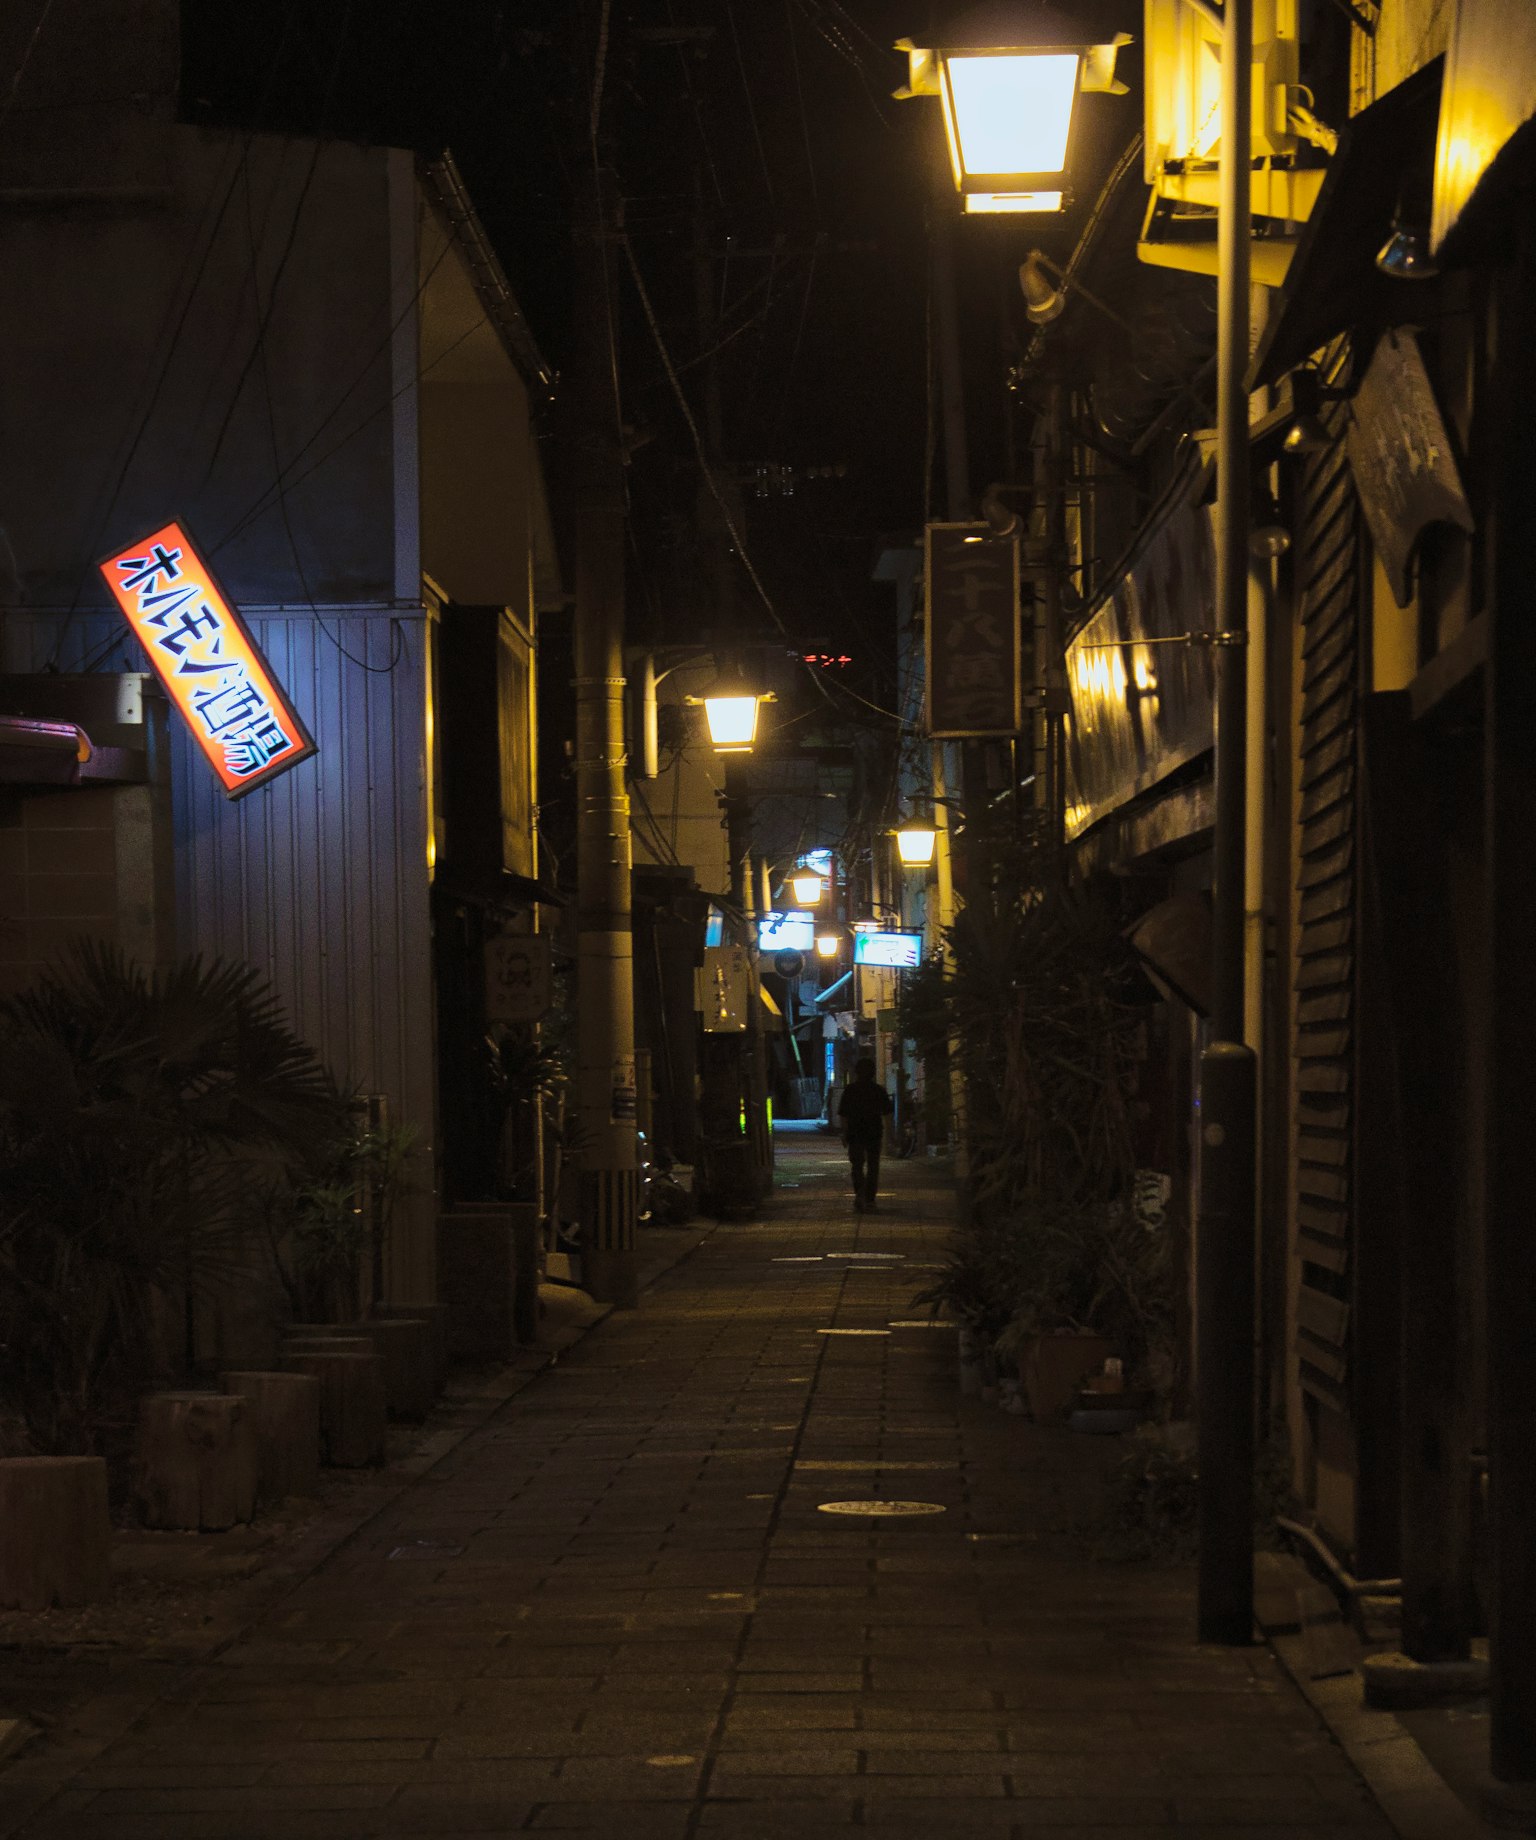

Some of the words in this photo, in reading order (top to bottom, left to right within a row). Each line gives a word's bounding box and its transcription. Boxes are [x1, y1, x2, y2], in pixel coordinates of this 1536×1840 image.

[117, 544, 292, 775] ホルモン酒場
